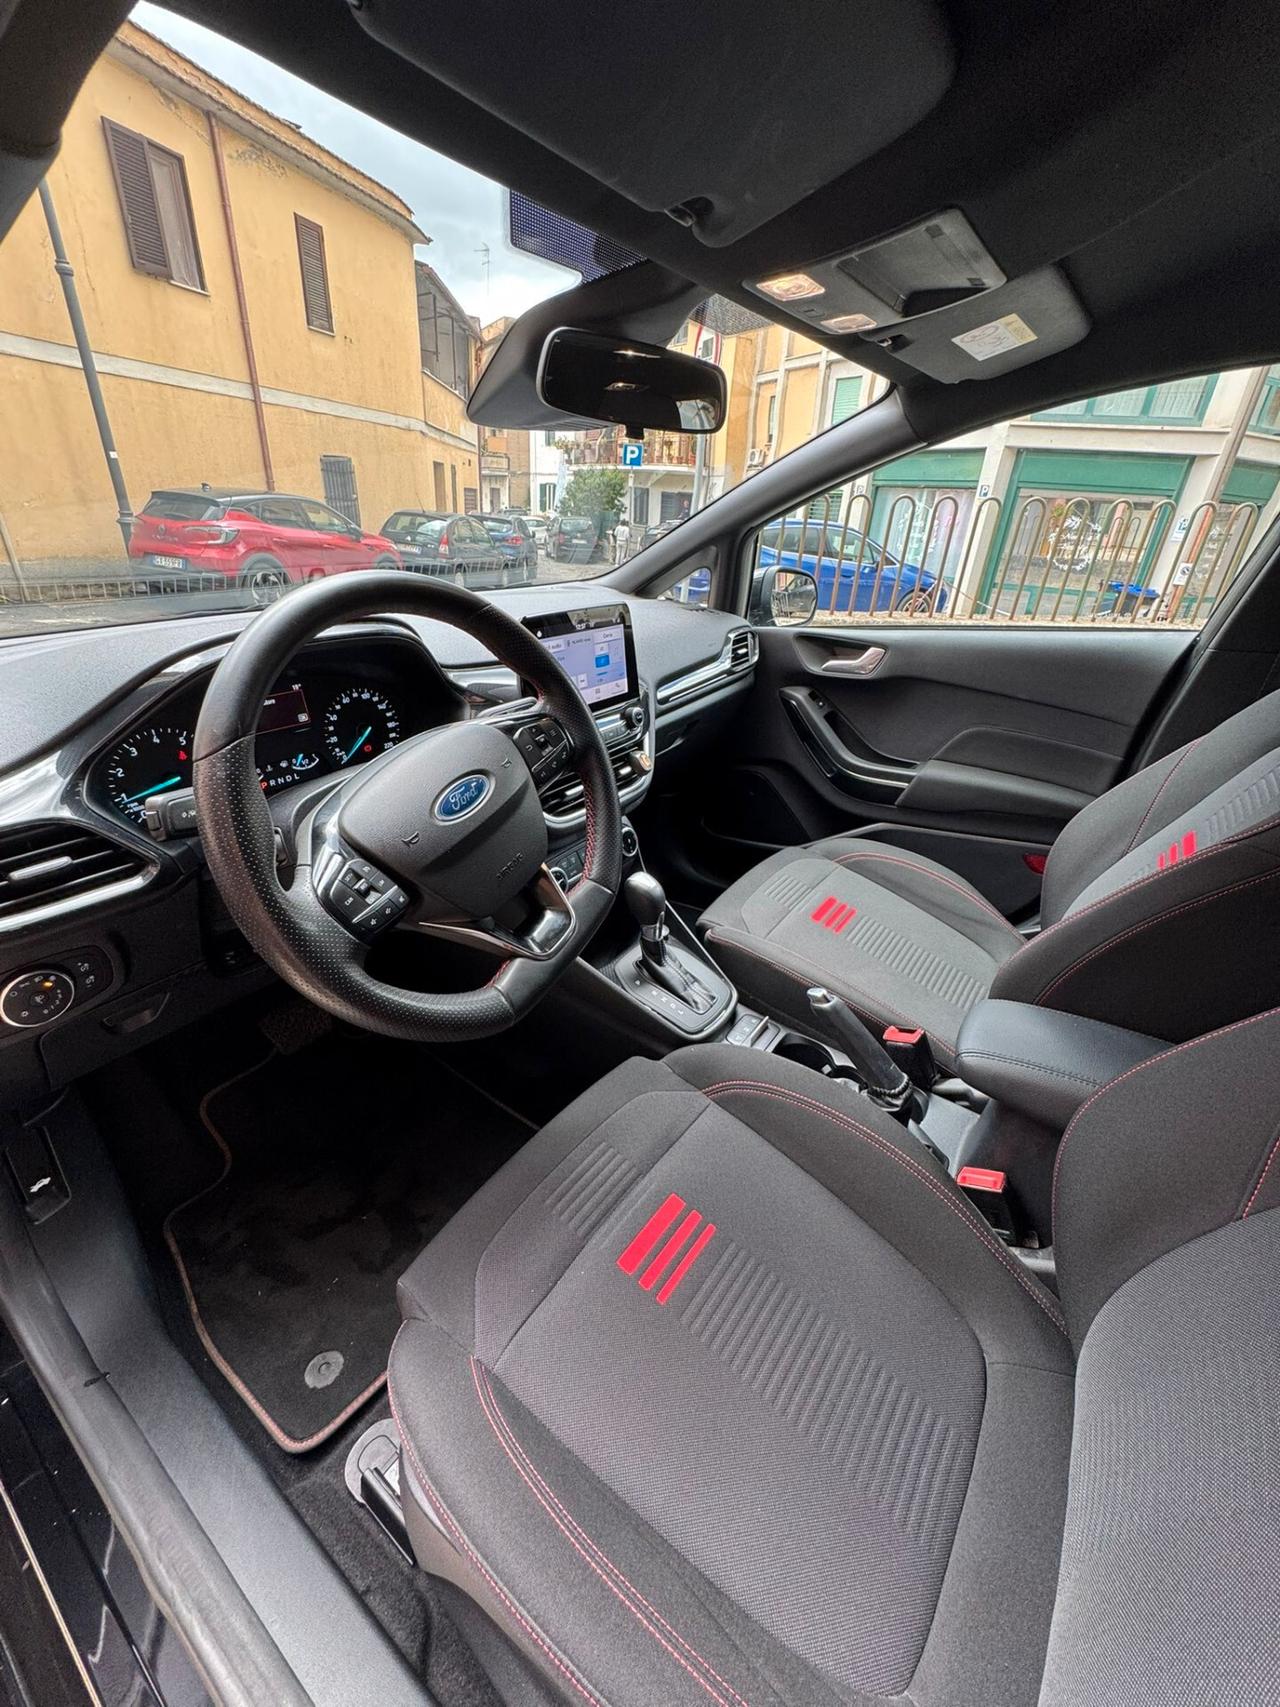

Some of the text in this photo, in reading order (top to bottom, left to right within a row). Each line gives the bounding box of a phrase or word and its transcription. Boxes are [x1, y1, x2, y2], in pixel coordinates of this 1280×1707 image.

[626, 446, 640, 464] P
[981, 485, 989, 497] P
[153, 735, 160, 744] 4
[178, 736, 186, 746] 5
[129, 747, 138, 757] 3
[116, 767, 125, 778] 2
[261, 781, 268, 789] P
[269, 779, 276, 787] R
[294, 772, 300, 780] L
[449, 781, 478, 811] Ford
